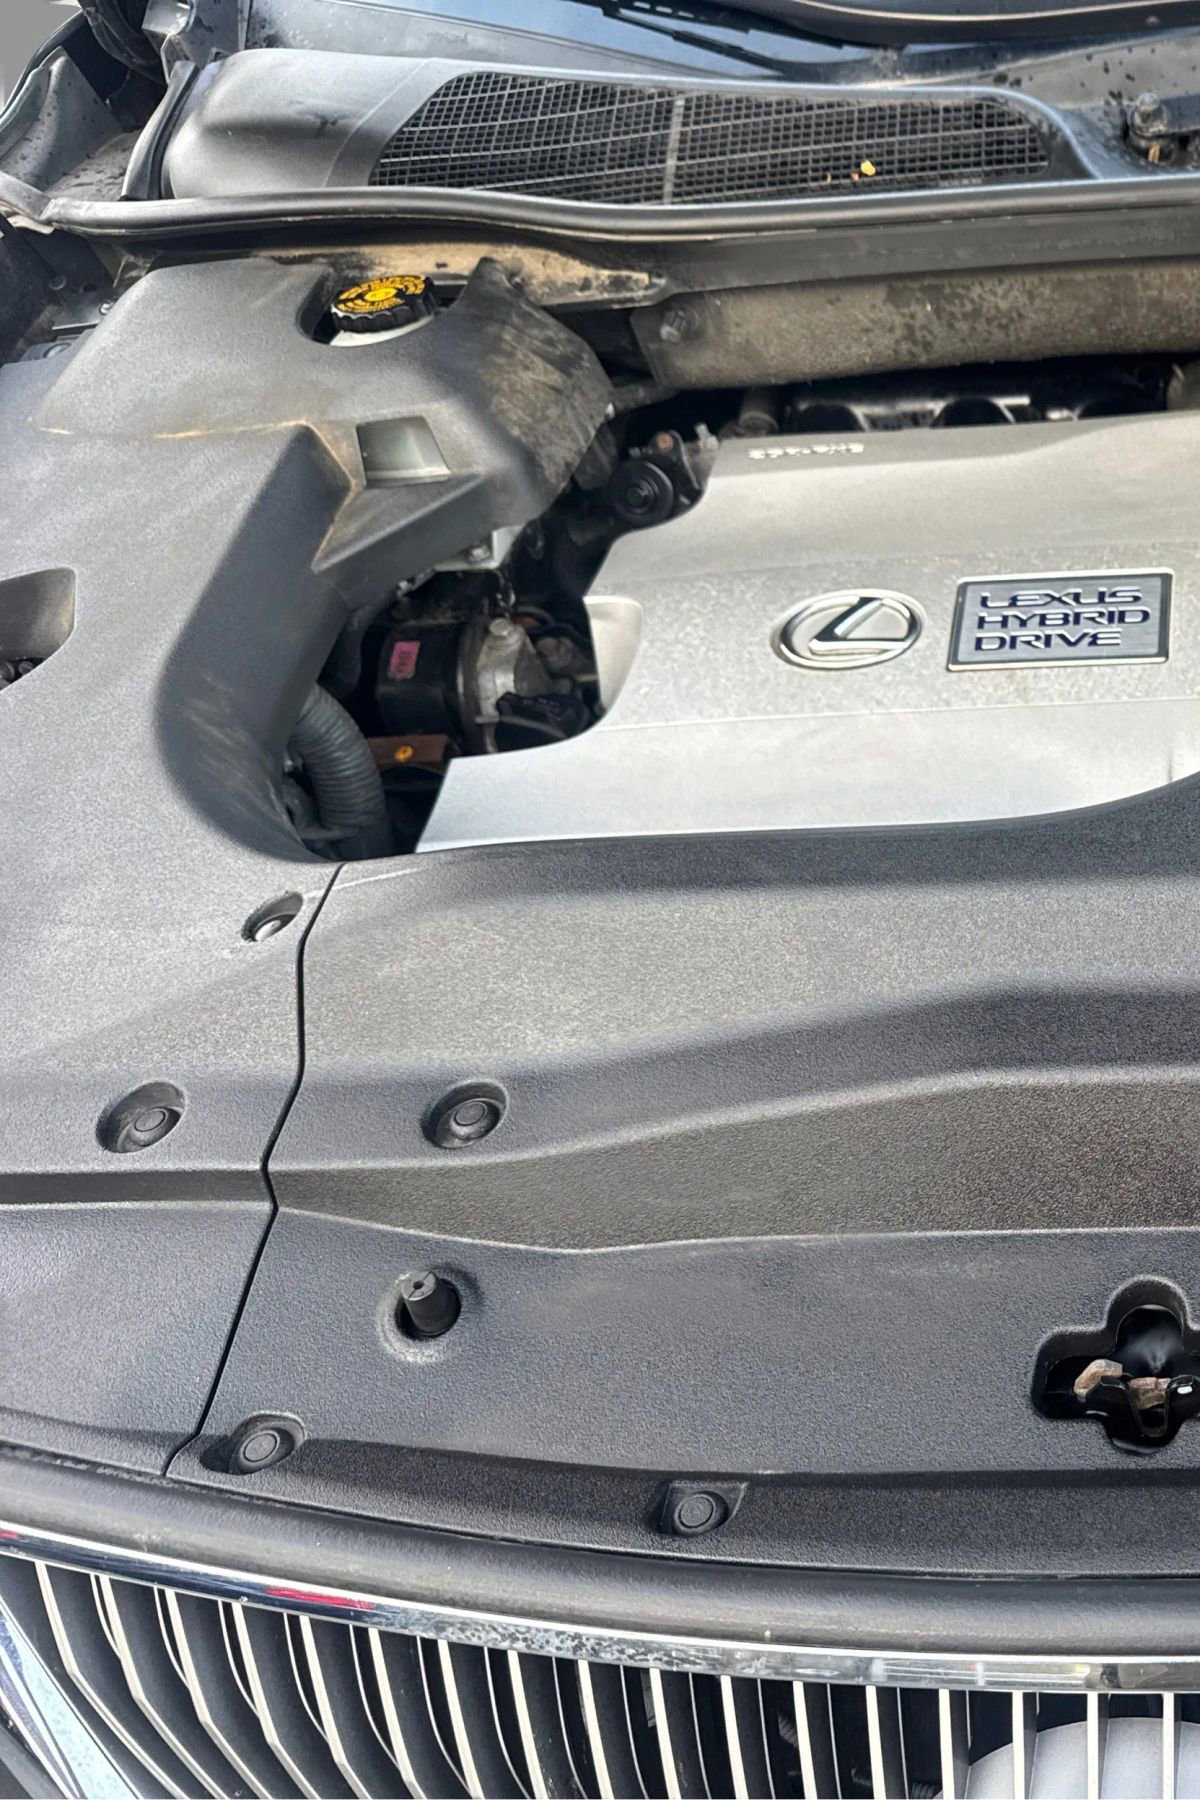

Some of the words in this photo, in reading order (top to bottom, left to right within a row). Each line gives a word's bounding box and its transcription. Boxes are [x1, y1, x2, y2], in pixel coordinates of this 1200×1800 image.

[979, 585, 1143, 609] LEXUS
[976, 605, 1151, 630] HYBRID
[974, 627, 1123, 651] DRIVE
